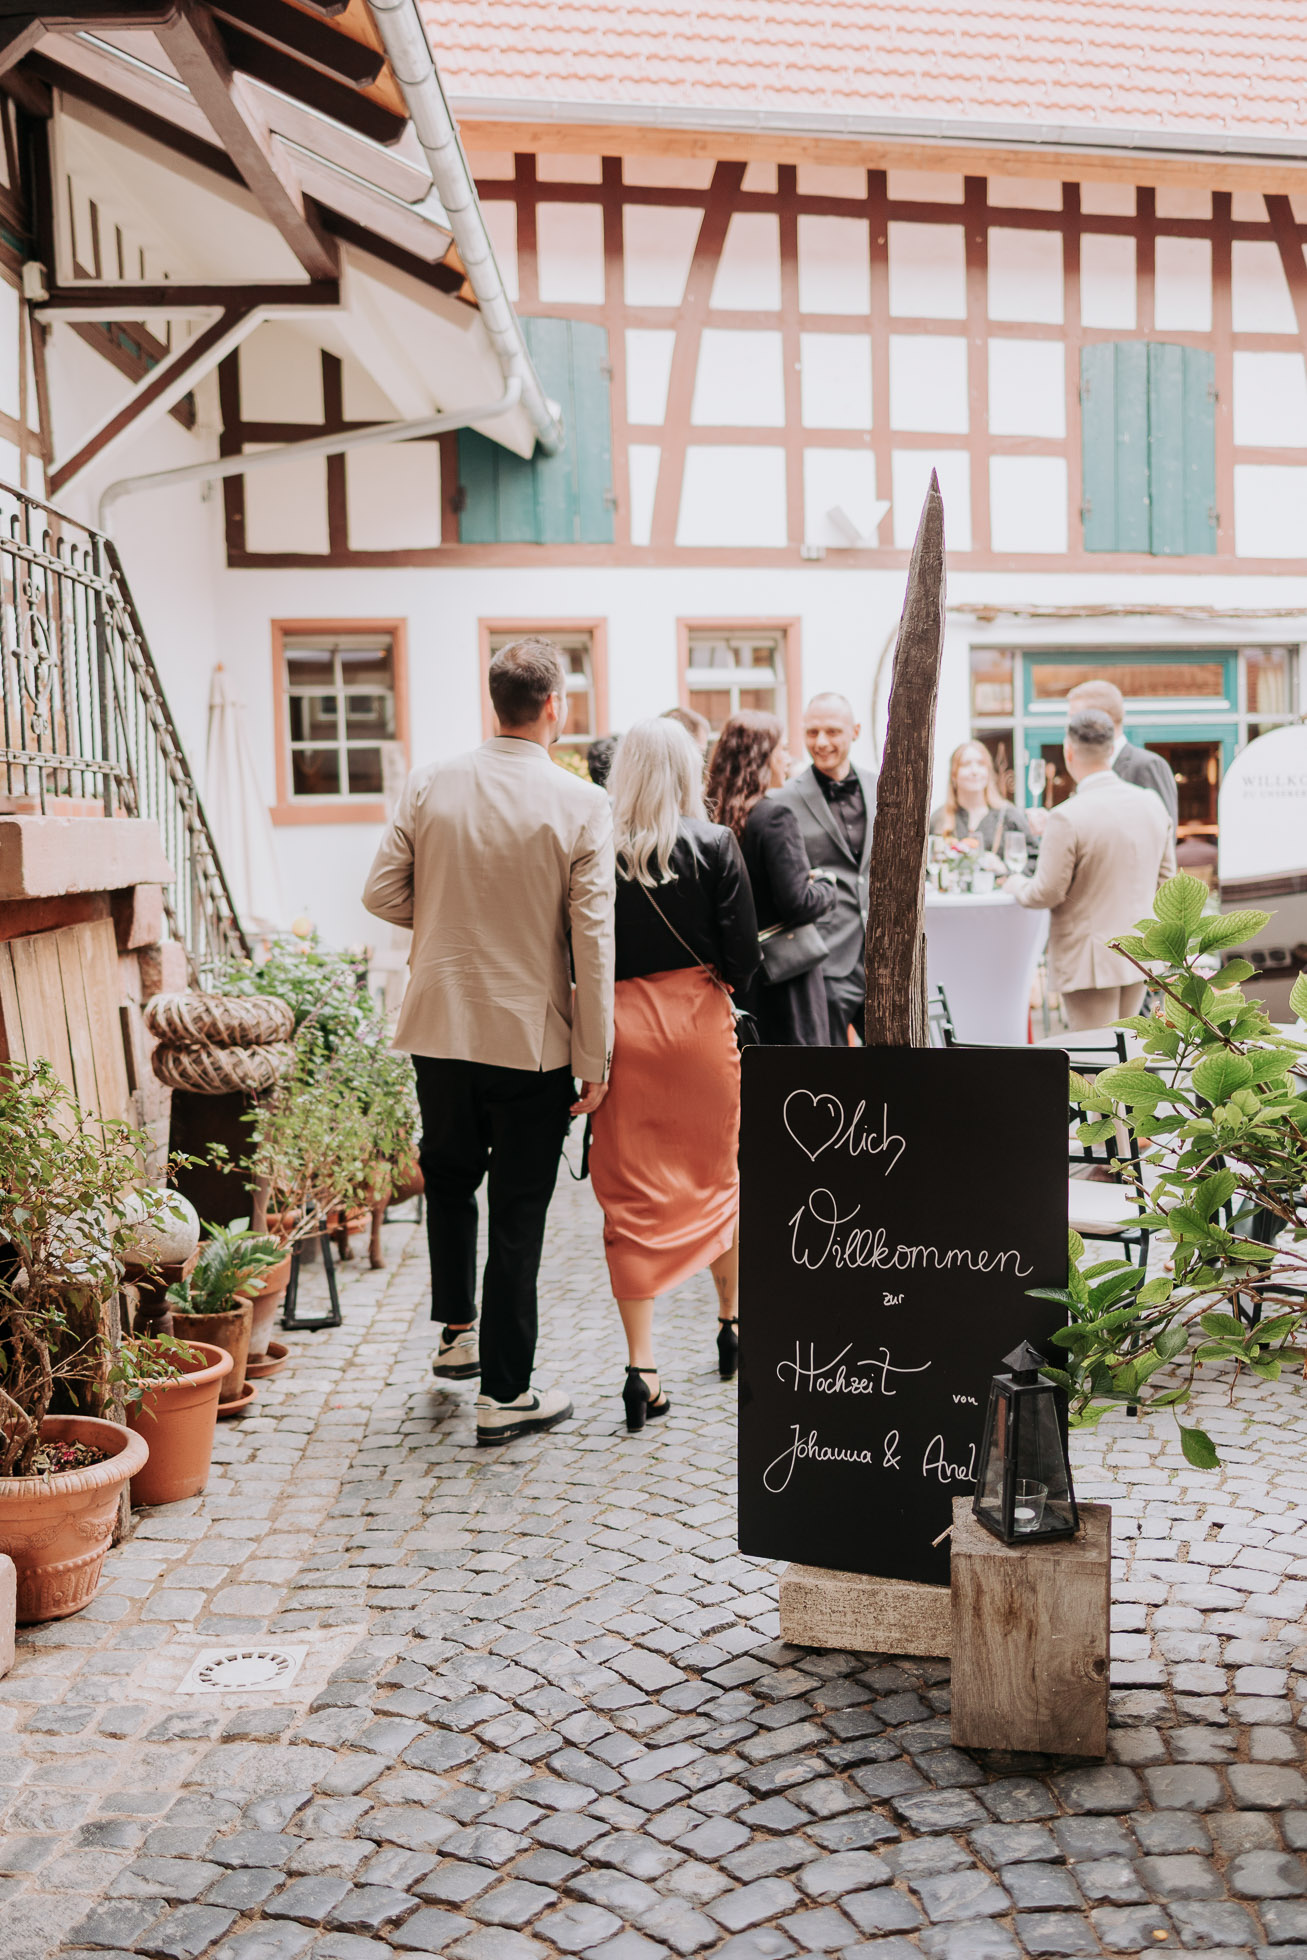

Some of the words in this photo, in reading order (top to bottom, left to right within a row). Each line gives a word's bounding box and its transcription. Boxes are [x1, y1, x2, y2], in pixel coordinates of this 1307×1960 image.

[834, 1099, 905, 1176] lich
[789, 1188, 1034, 1277] Willkommen
[883, 1292, 905, 1306] zur
[777, 1340, 932, 1396] Hochzeit
[952, 1394, 978, 1406] von
[763, 1424, 873, 1493] Johanna
[882, 1429, 902, 1470] &
